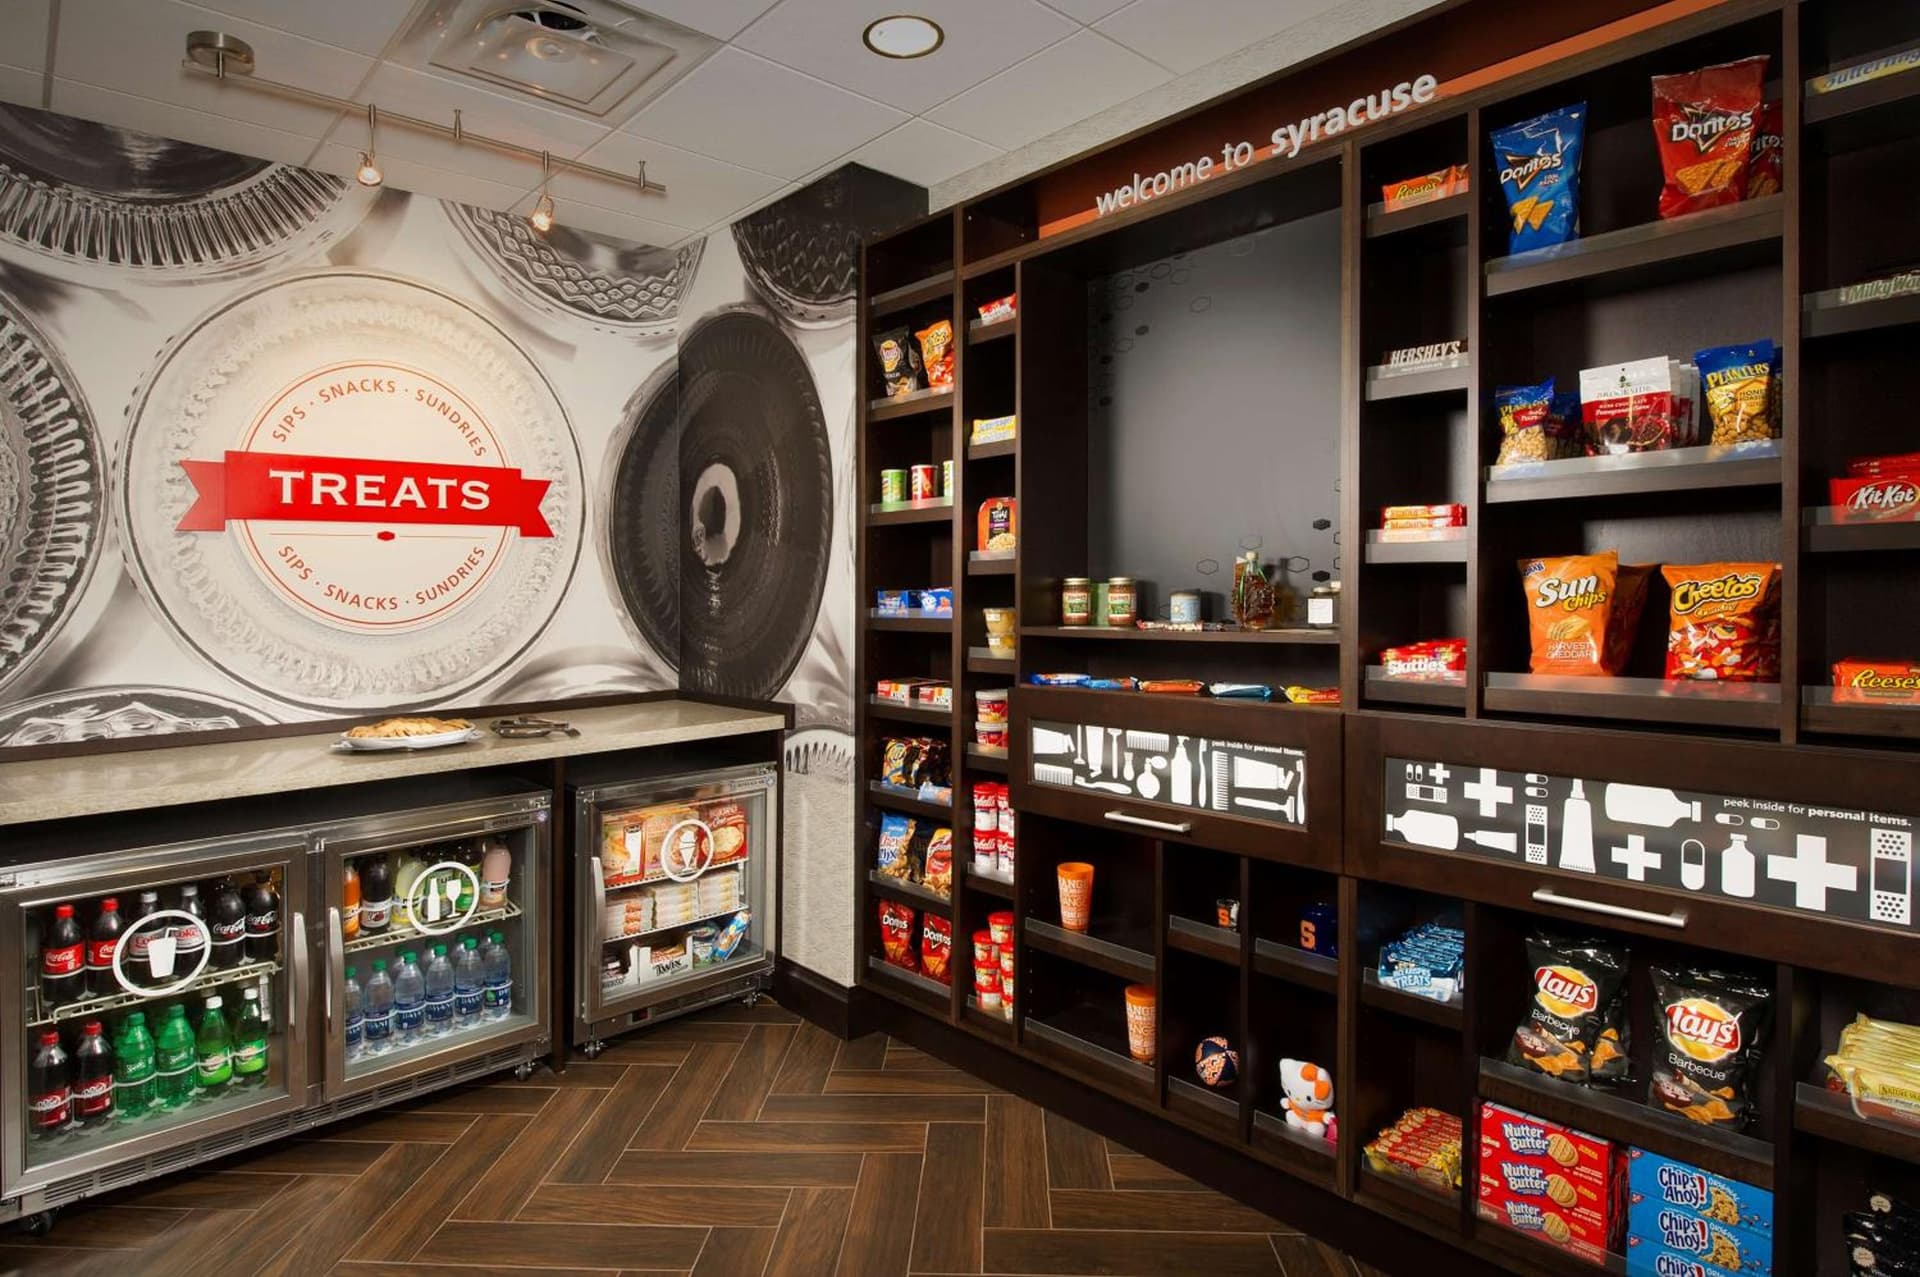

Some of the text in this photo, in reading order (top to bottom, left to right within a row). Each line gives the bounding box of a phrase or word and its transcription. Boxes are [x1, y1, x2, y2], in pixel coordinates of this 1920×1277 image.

[1671, 110, 1753, 142] Doritos
[1096, 74, 1438, 216] welcome to syracuse
[1500, 153, 1563, 184] Doritos
[1390, 341, 1461, 367] HERSHEY'S
[1706, 362, 1770, 388] PLANTERS
[272, 378, 487, 458] SIPS SNACKS SUNDRIES
[268, 468, 491, 511] TREATS
[278, 544, 486, 611] SIPS SNACKS SUNDRIES
[1535, 575, 1597, 608] Sun
[1673, 575, 1761, 613] Cheetos
[1723, 799, 1912, 827] peek inside for personal items.
[1300, 921, 1316, 949] S
[1394, 974, 1431, 989] TREATS
[1537, 969, 1592, 1006] Lay's
[1531, 1008, 1580, 1036] Barbecue
[1668, 1007, 1737, 1045] Lay's
[1668, 1052, 1727, 1081] Barbecue
[1502, 1122, 1545, 1138] Nutter
[1509, 1137, 1549, 1151] Butter
[1501, 1162, 1543, 1178] Nutter
[1507, 1177, 1548, 1191] Butter
[1659, 1167, 1697, 1189] Chips
[1505, 1200, 1540, 1214] Nutter
[1511, 1213, 1545, 1226] Butter
[1660, 1212, 1698, 1234] Chips
[1657, 1256, 1696, 1277] Chips
